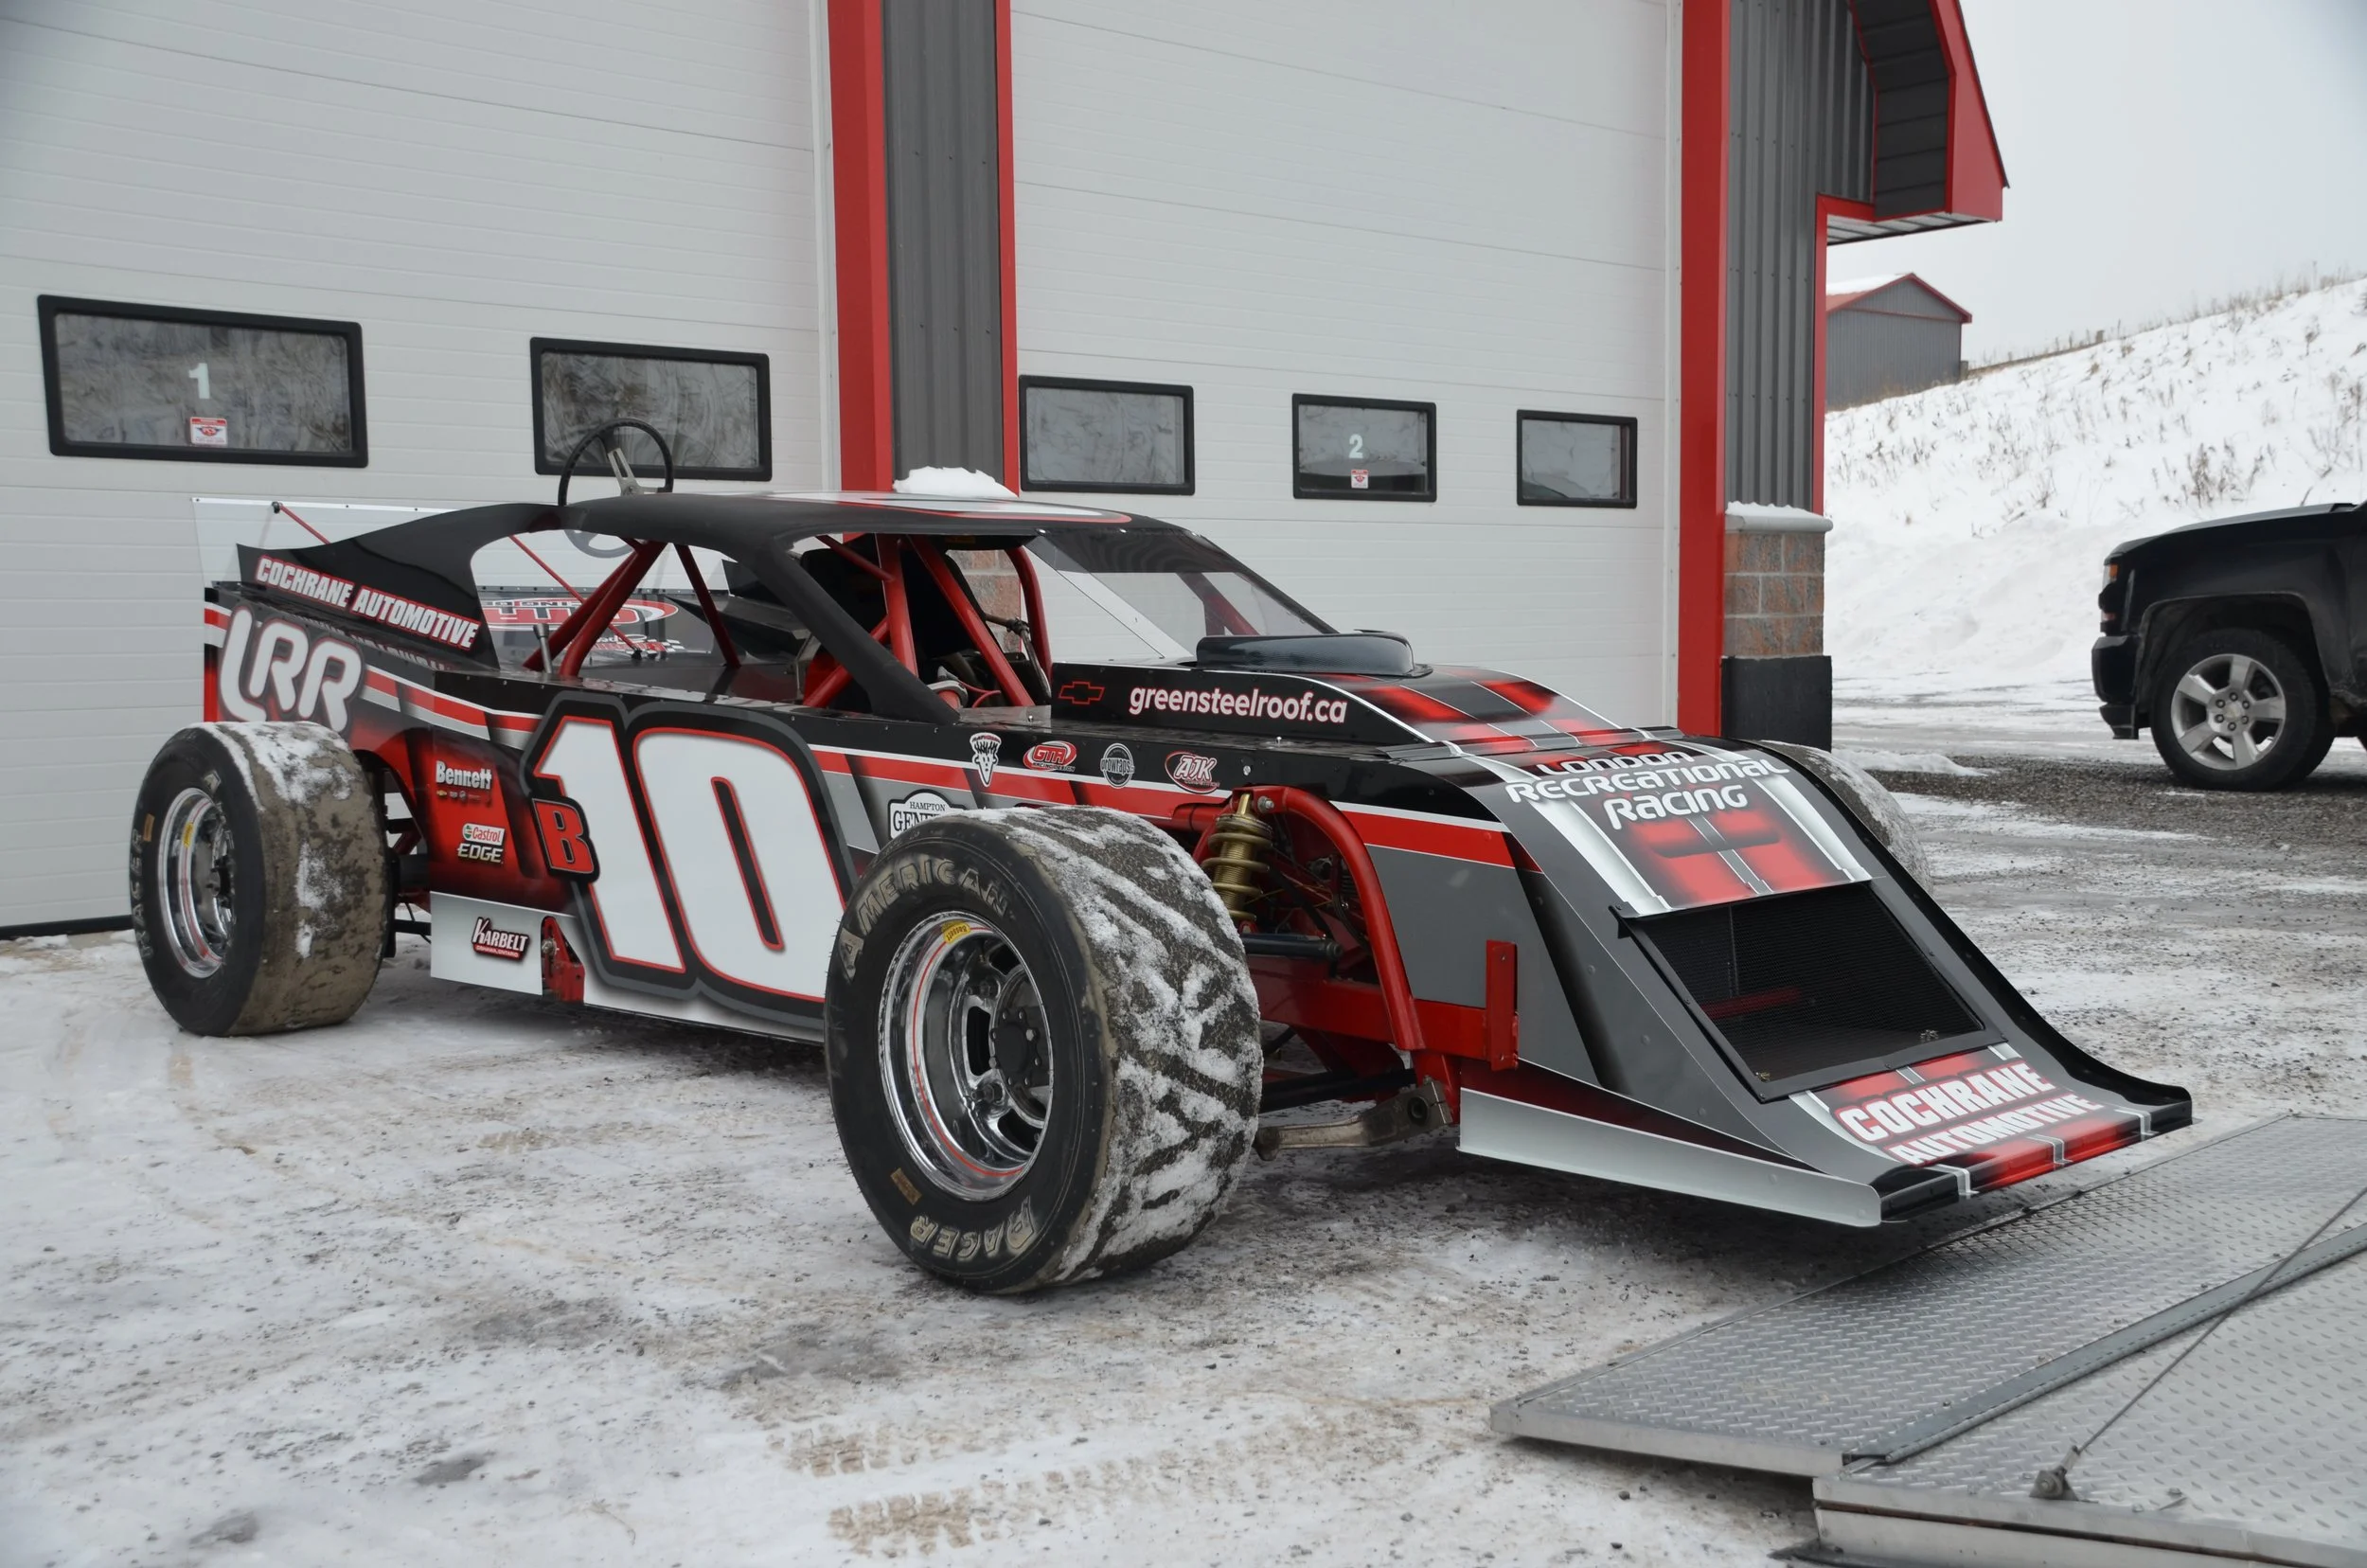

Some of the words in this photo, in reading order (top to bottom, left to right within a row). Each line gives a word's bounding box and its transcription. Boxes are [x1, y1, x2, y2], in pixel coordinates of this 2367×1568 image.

[188, 363, 210, 400] 1
[1348, 434, 1363, 459] 2
[256, 556, 353, 607] COCHRANE
[352, 587, 480, 649] AUTOMOTIVE
[220, 608, 362, 732] LRR
[1129, 686, 1348, 723] greensteelroof.ca
[436, 760, 492, 790] Bennett
[1174, 755, 1217, 781] AJK
[909, 801, 946, 811] HAMPTON
[457, 843, 504, 864] EDGE
[472, 827, 502, 843] Castrol
[534, 799, 596, 876] B
[533, 715, 846, 1004] 10
[472, 918, 528, 952] KARBELT
[1839, 1061, 2056, 1142] COCHRANE
[1888, 1094, 2105, 1166] AUTOMOTIVE
[910, 1195, 1035, 1259] RACER
